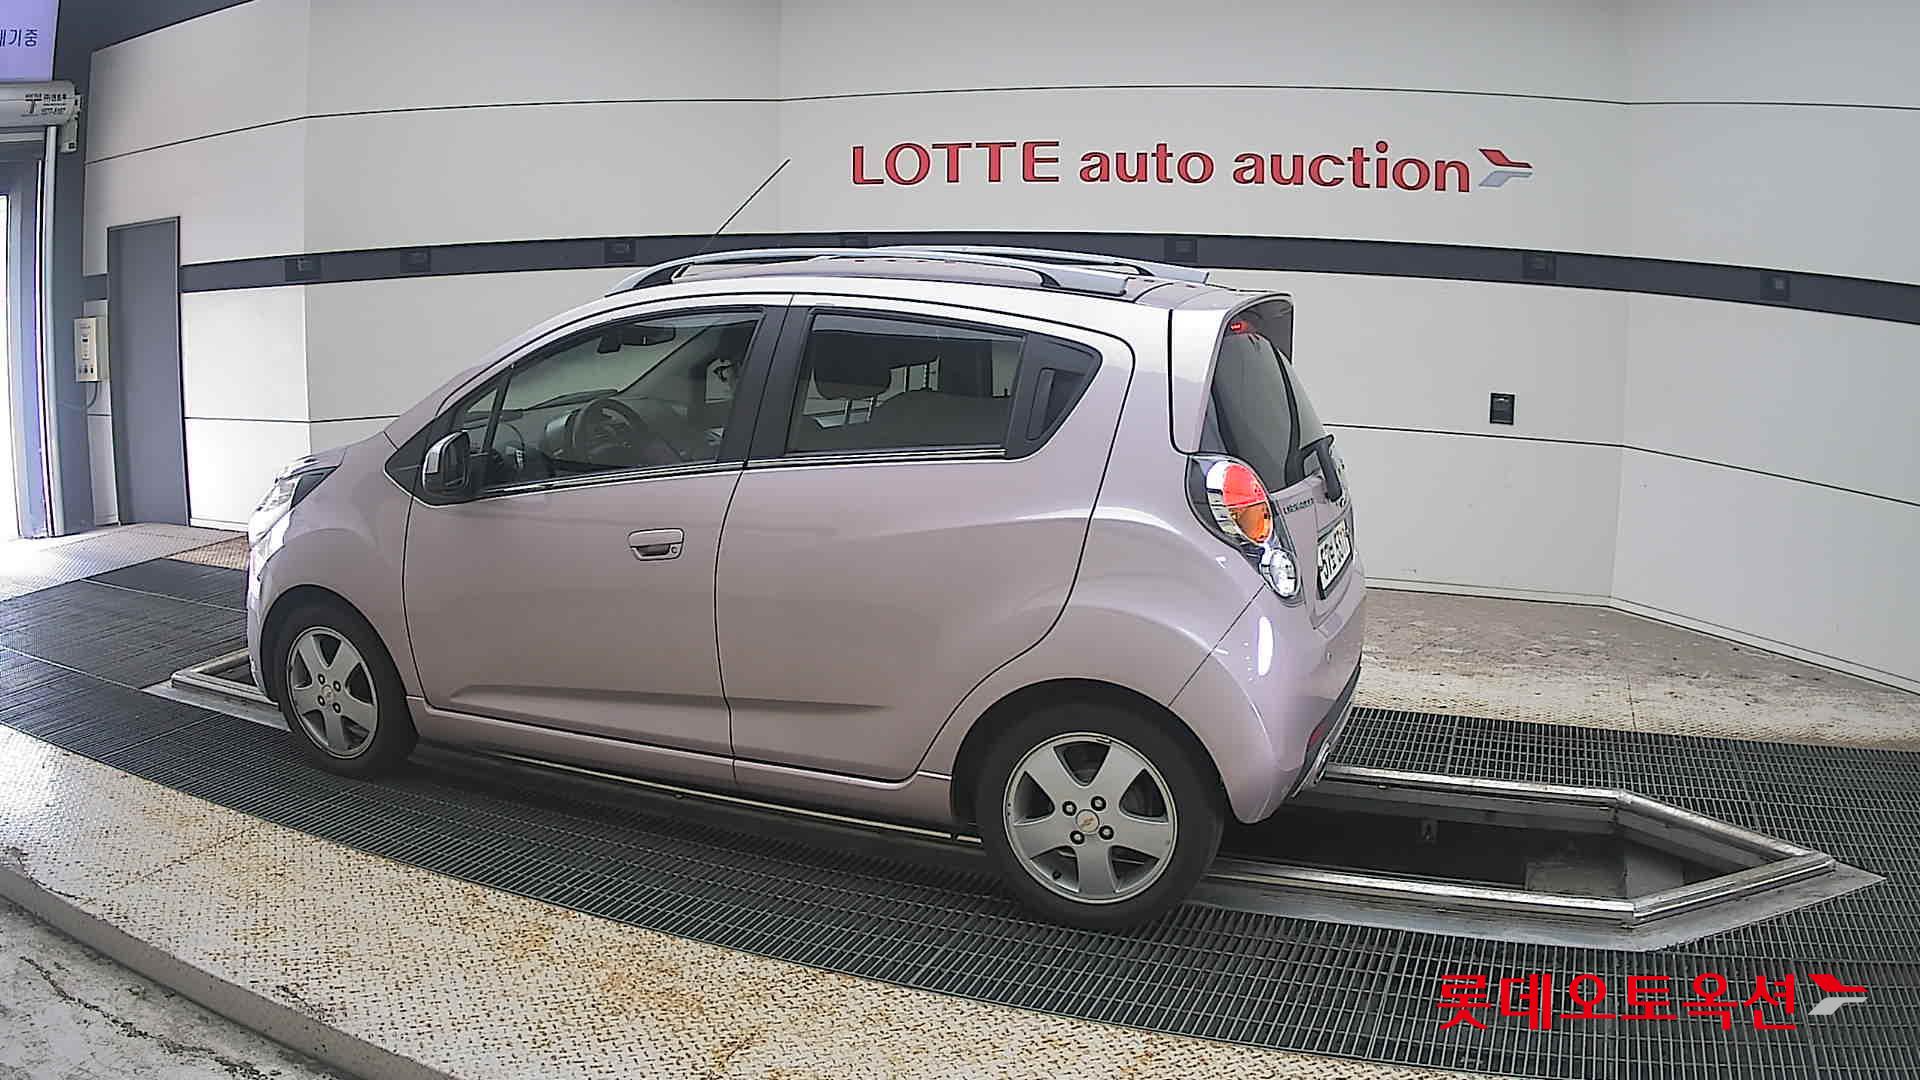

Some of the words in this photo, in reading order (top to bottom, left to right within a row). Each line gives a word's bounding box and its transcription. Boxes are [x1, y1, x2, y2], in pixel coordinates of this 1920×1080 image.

[851, 140, 1060, 185] LOTTE
[1078, 142, 1215, 184] auto
[1232, 141, 1471, 193] auction
